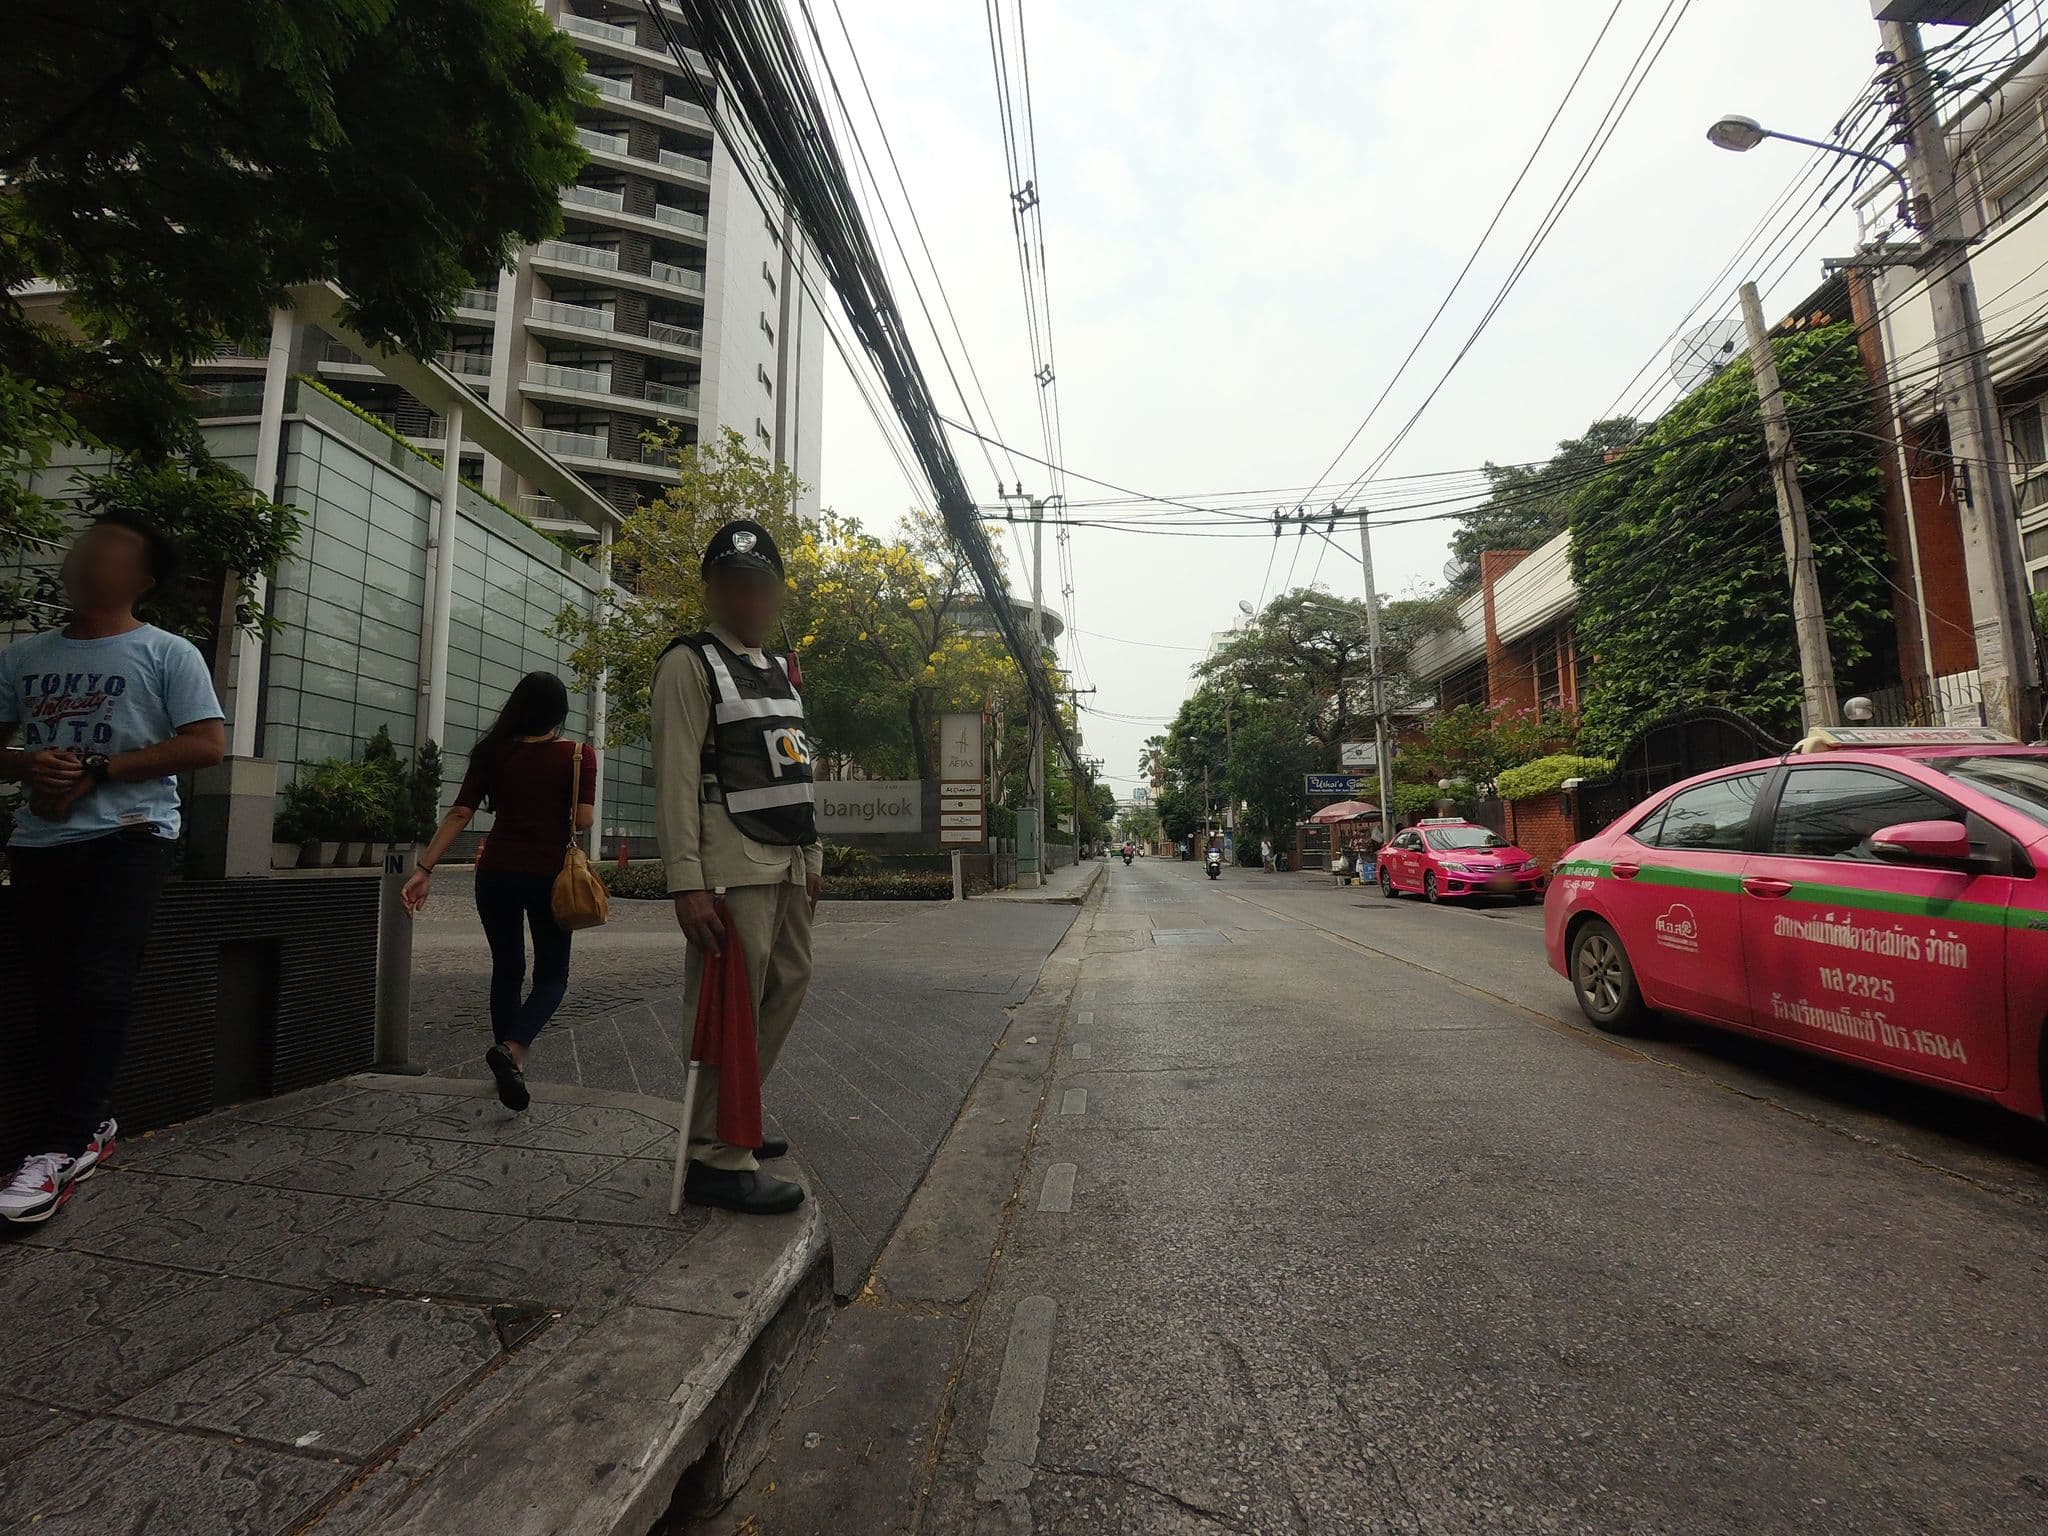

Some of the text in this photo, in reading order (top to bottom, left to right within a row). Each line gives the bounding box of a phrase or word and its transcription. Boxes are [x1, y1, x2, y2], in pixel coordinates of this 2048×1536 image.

[22, 672, 126, 697] TOKYO
[823, 798, 913, 821] bangkok
[384, 854, 403, 874] IN
[1925, 929, 1968, 968] จำกัด
[1846, 973, 1896, 1004] 2325
